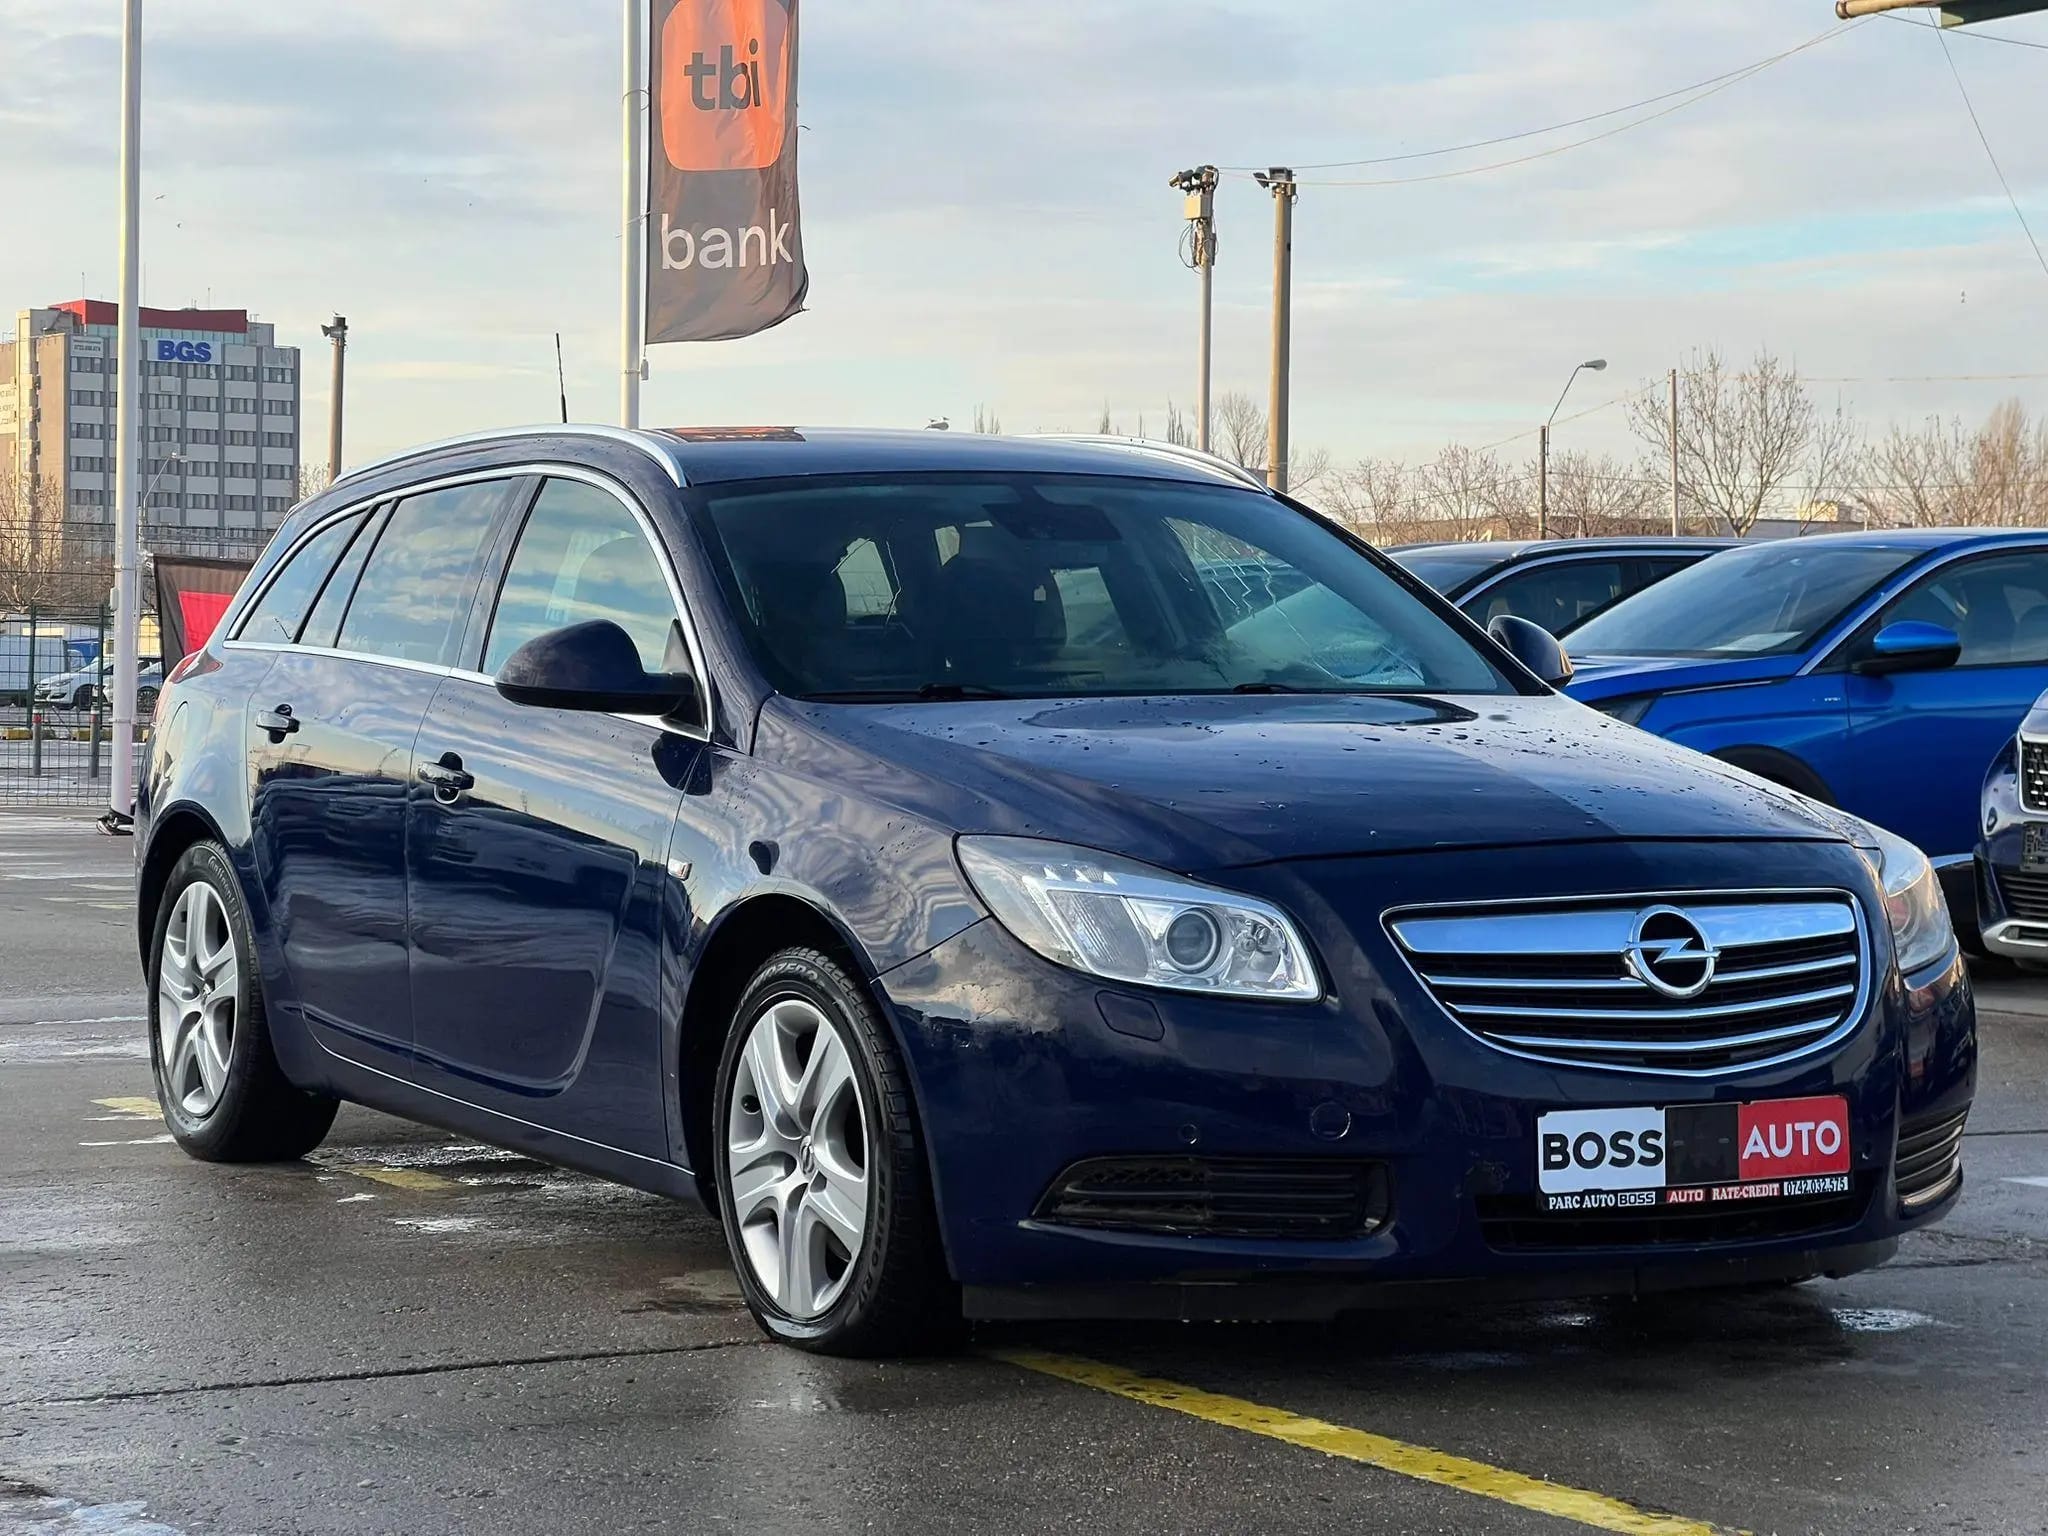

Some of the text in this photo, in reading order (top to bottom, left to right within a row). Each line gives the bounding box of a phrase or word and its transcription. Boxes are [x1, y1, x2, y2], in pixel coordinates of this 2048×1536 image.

[684, 38, 761, 111] tbi
[661, 208, 793, 270] bank
[158, 340, 211, 362] BGS
[1543, 1129, 1664, 1171] BOSS
[1743, 1119, 1841, 1160] AUTO
[1549, 1196, 1581, 1210] PARC
[1583, 1193, 1615, 1208] AUTO
[1618, 1191, 1655, 1207] BOSS
[1669, 1189, 1704, 1203] AUTO
